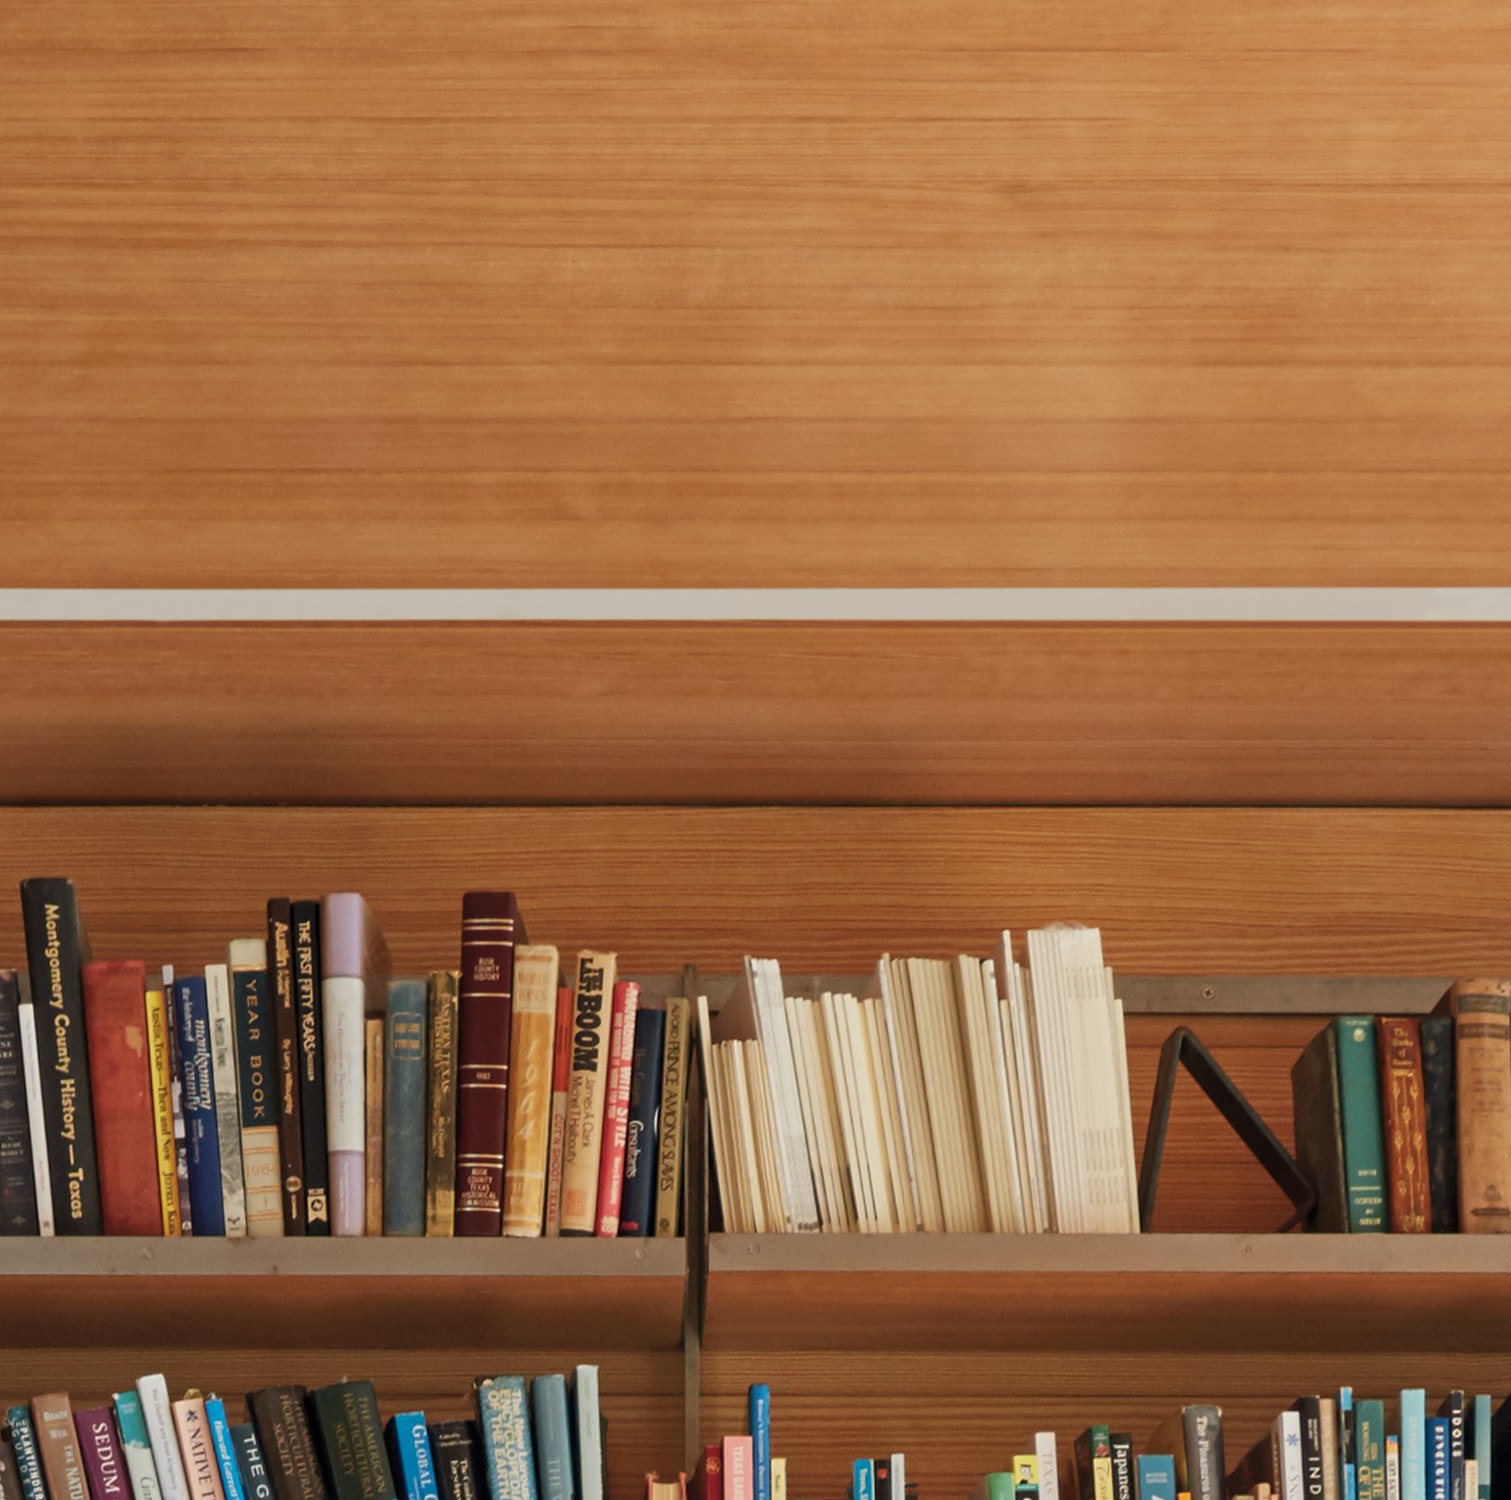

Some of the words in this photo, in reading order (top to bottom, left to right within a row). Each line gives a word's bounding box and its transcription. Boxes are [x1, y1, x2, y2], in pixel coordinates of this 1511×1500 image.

[43, 904, 65, 1008] Montgomery
[246, 979, 260, 1040] YEAR
[573, 992, 602, 1071] BOOM
[53, 1013, 75, 1072] County
[60, 1079, 79, 1140] History
[251, 1055, 266, 1118] BOOK
[68, 1168, 85, 1218] Texas
[92, 1422, 120, 1493] SEDUM
[243, 1432, 265, 1490] THE
